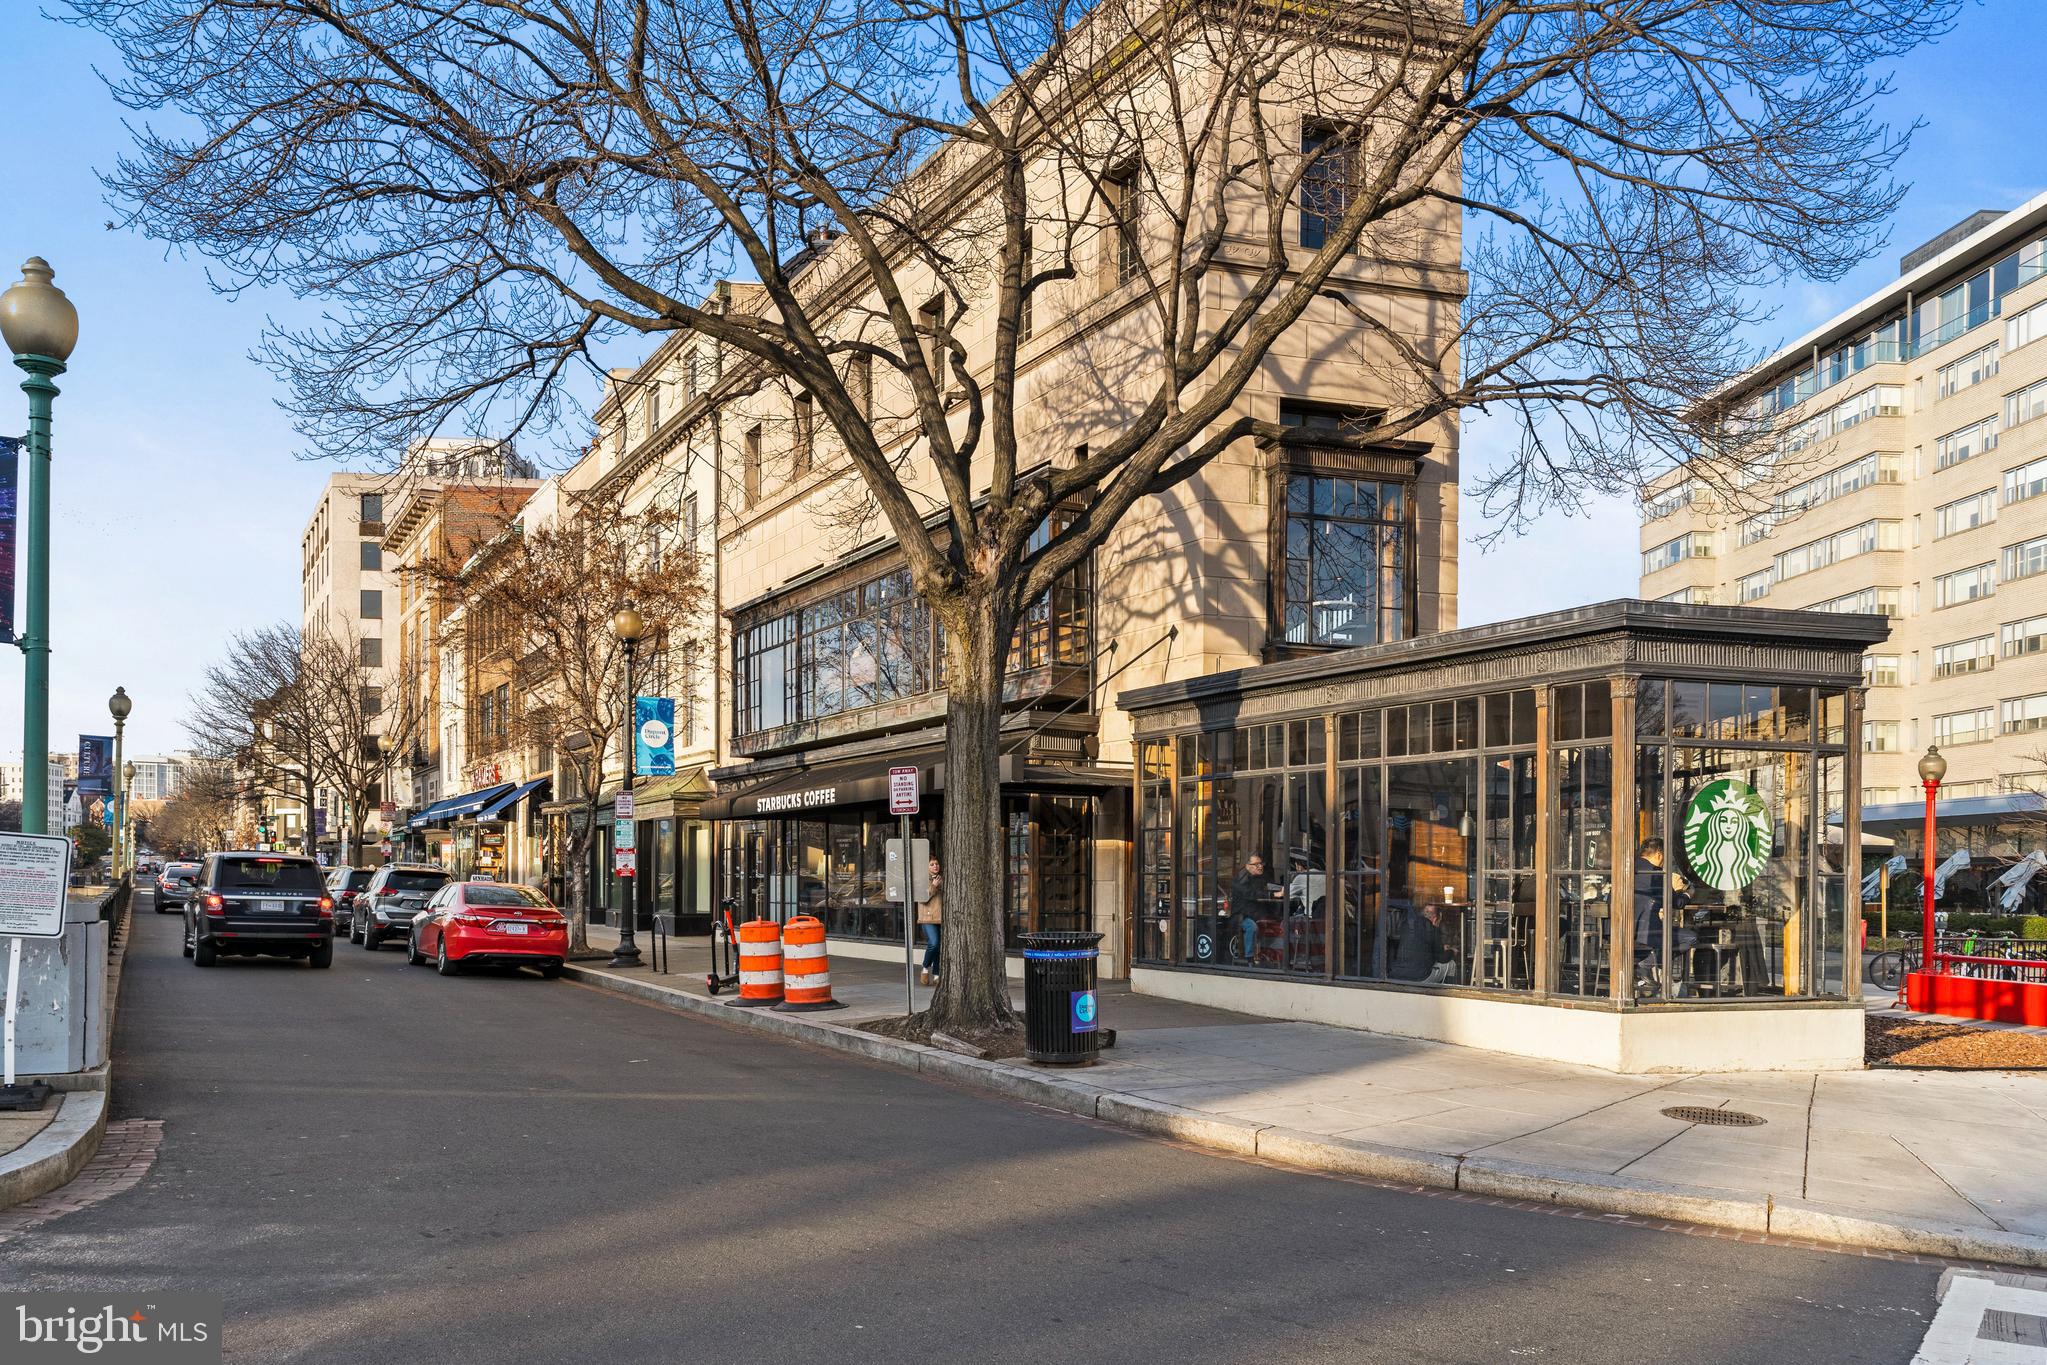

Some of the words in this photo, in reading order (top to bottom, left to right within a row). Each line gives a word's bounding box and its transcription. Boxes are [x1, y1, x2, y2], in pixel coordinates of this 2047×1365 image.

[83, 741, 91, 776] CULTURE
[757, 793, 801, 812] STARBUCKS
[804, 788, 836, 806] COFFEE
